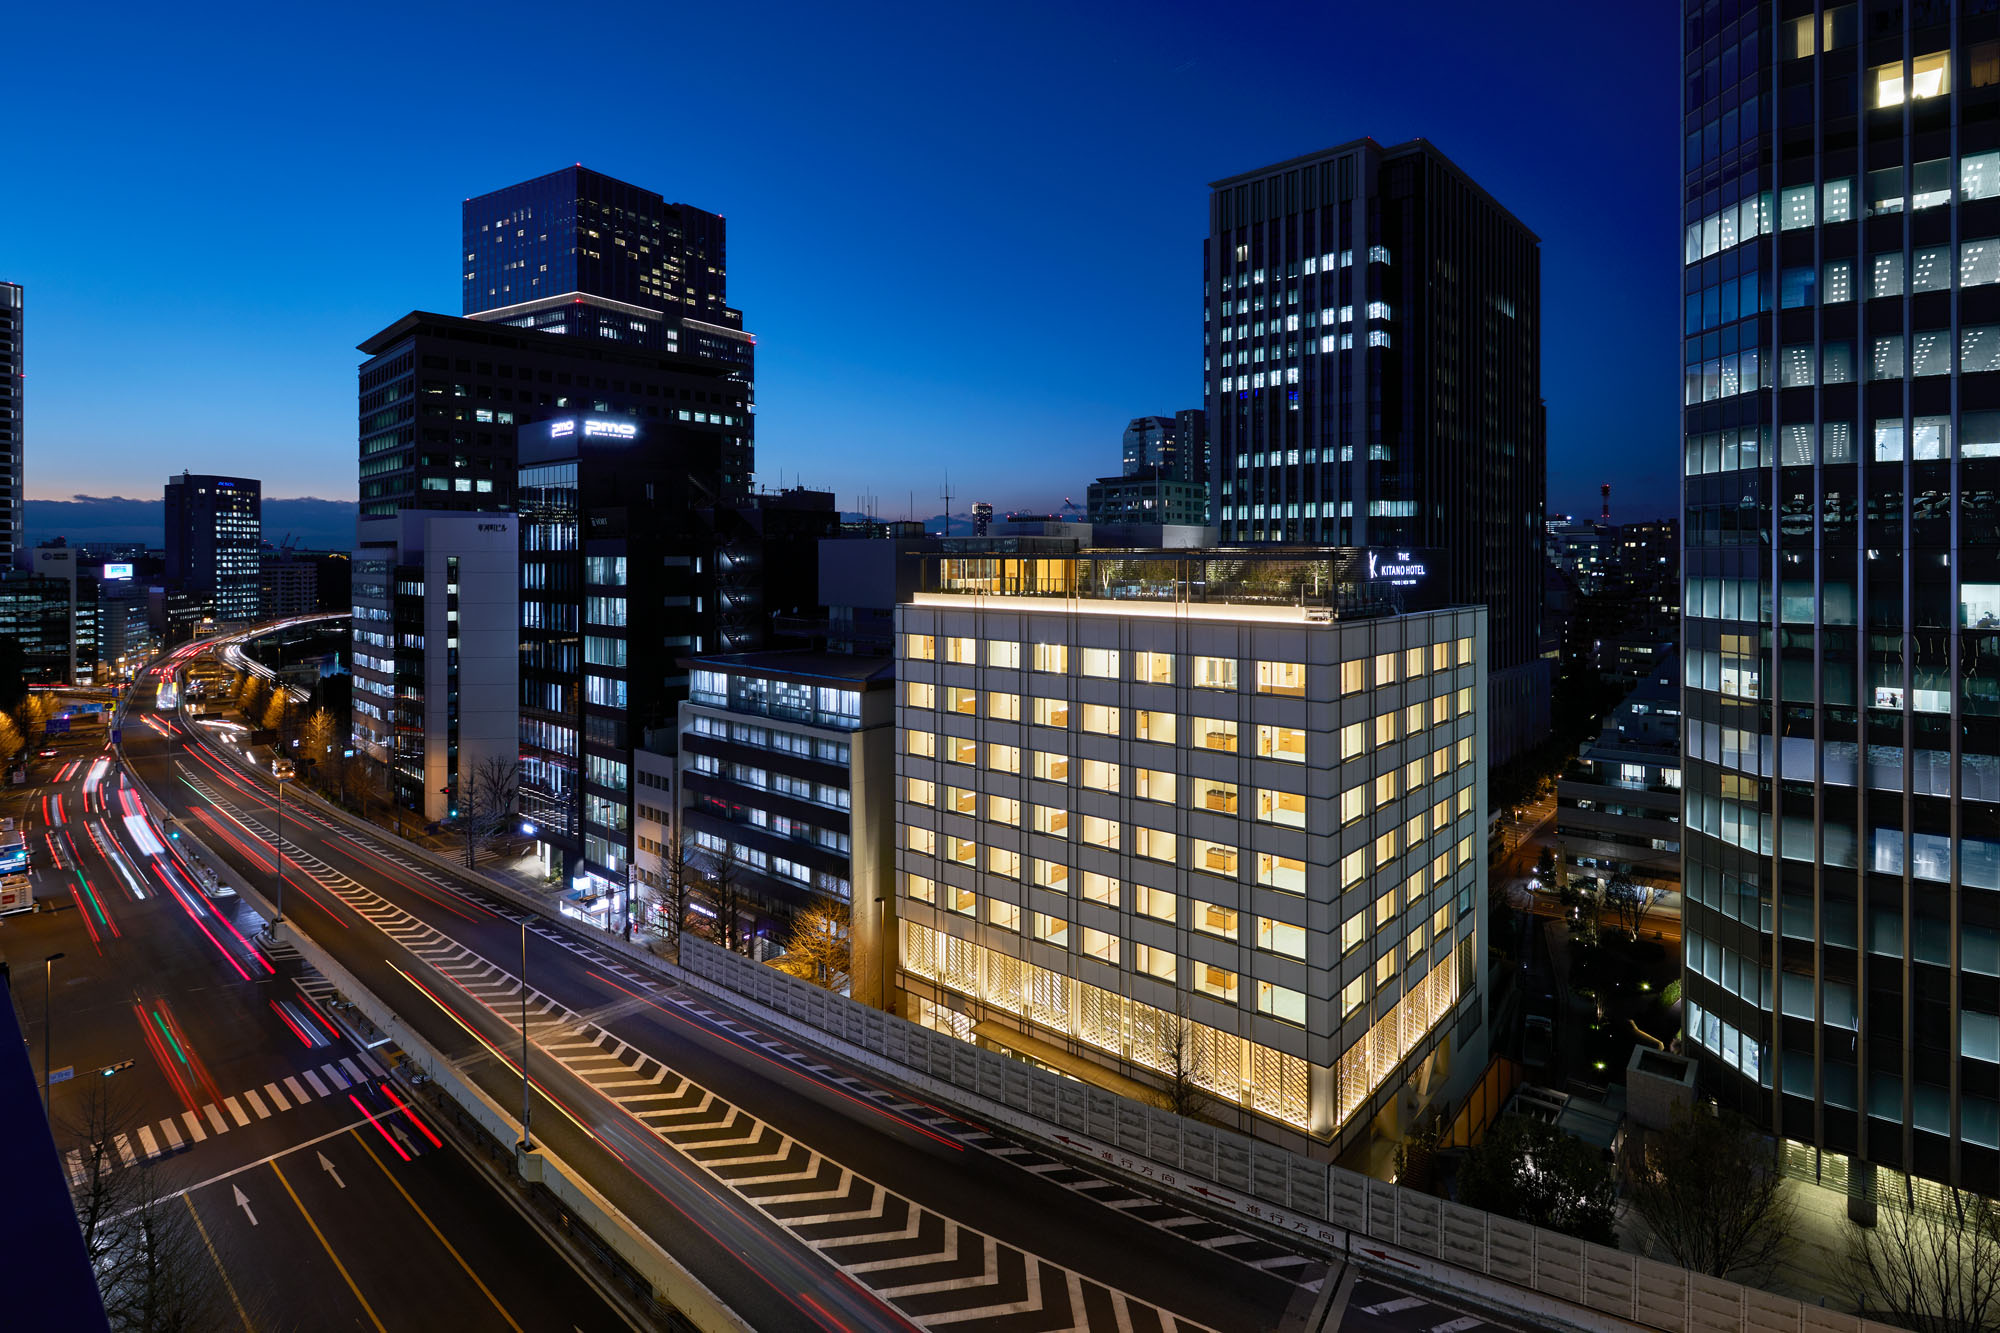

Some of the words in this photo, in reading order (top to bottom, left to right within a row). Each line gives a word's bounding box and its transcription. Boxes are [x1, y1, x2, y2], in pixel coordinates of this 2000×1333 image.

[585, 420, 636, 436] pmo
[1397, 552, 1410, 561] THE
[1381, 565, 1405, 576] KITANO
[1406, 565, 1426, 575] HOTEL
[1101, 1150, 1175, 1184] 進行方向
[1246, 1203, 1335, 1243] 進行方向
